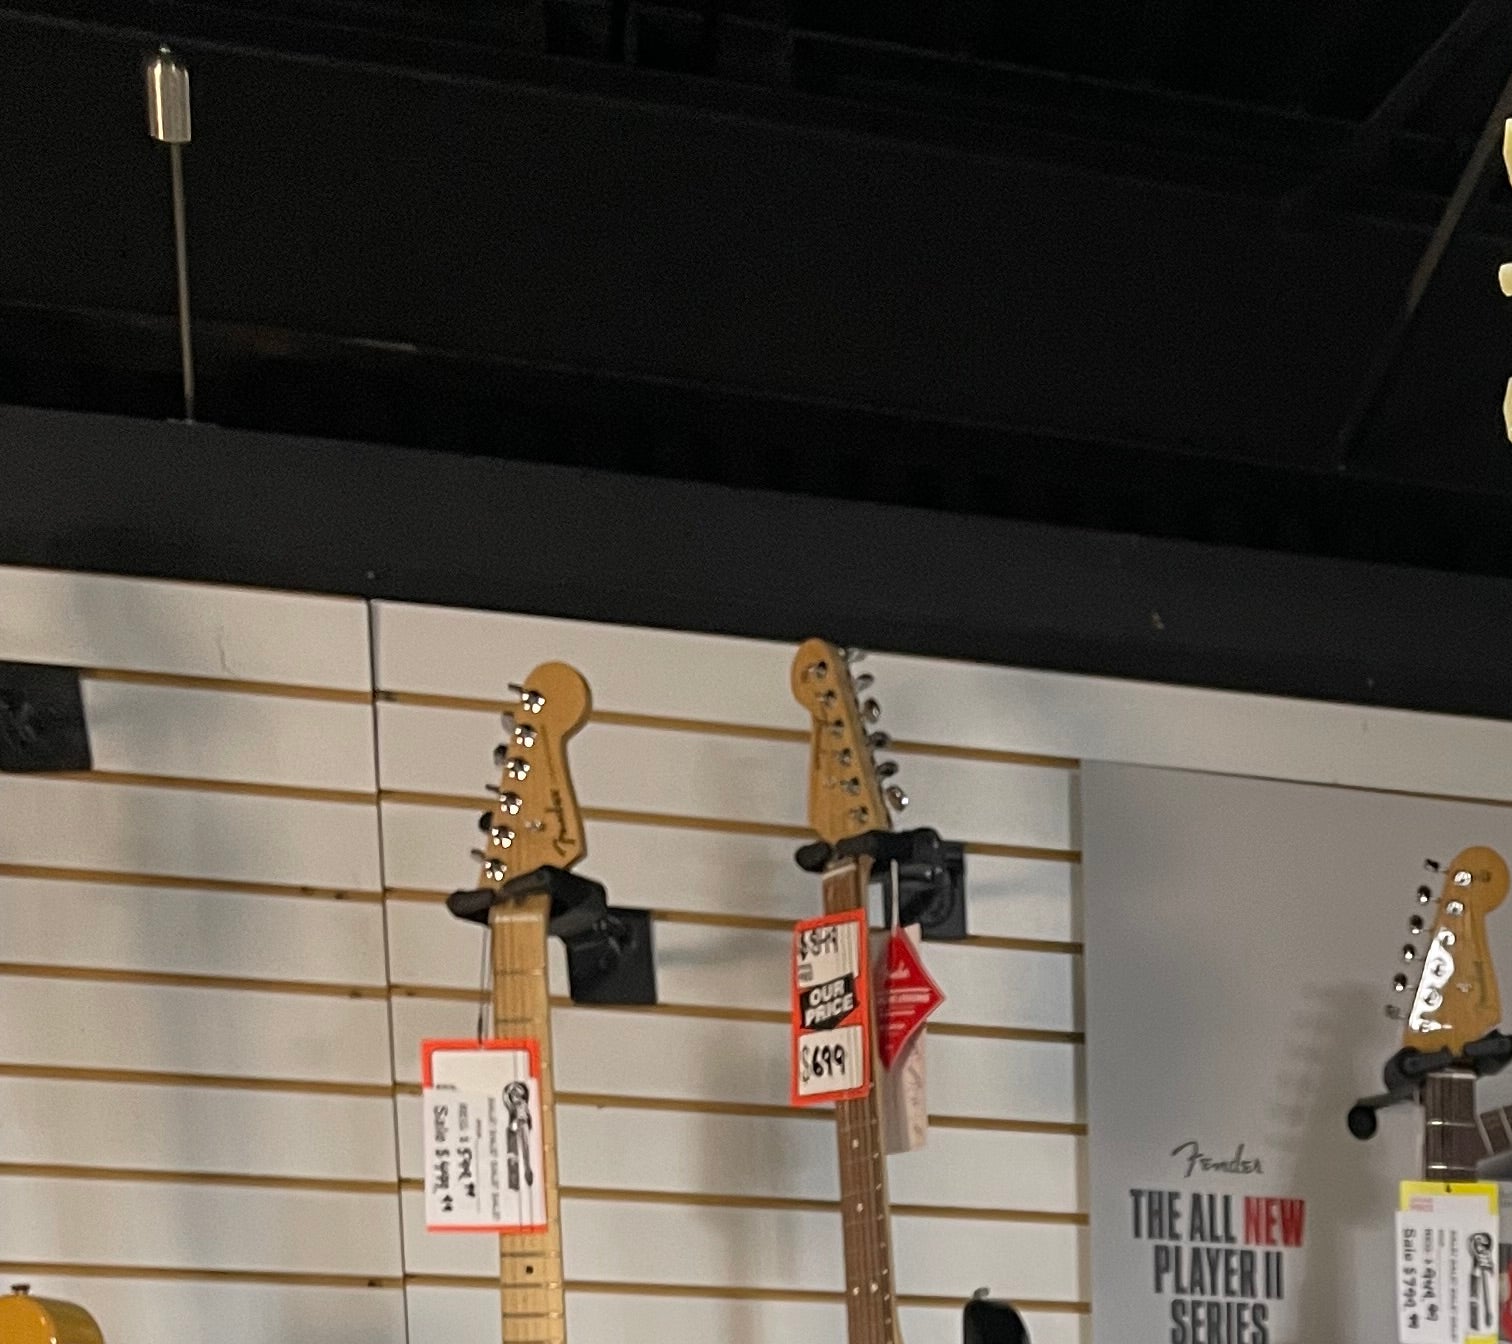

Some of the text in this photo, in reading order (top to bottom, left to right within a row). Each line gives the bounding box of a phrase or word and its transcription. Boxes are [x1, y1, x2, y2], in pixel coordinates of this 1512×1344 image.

[804, 992, 854, 1029] PRICE
[809, 979, 845, 1008] OUR
[802, 1044, 846, 1083] $699
[1172, 1141, 1265, 1178] Fender
[1129, 1188, 1306, 1248] THE ALL NEW
[1153, 1245, 1284, 1300] PLAYER II
